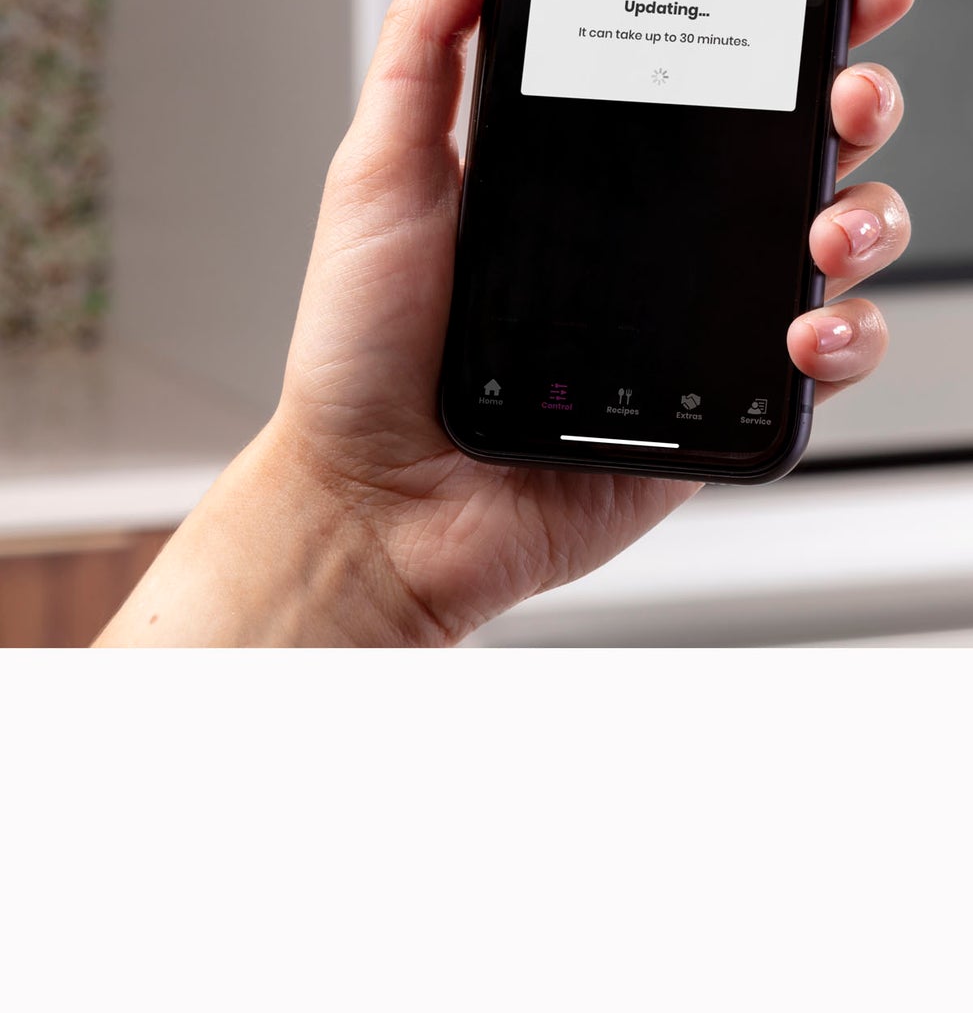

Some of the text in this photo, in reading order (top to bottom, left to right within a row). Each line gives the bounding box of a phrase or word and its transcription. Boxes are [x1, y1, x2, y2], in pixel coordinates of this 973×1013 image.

[624, 0, 710, 21] Updating...
[578, 27, 751, 47] It can take up to 30 minutes.
[478, 396, 504, 406] Home
[541, 401, 574, 411] Control
[606, 405, 640, 417] Recipes
[676, 411, 703, 421] Extras
[740, 416, 772, 426] Service
